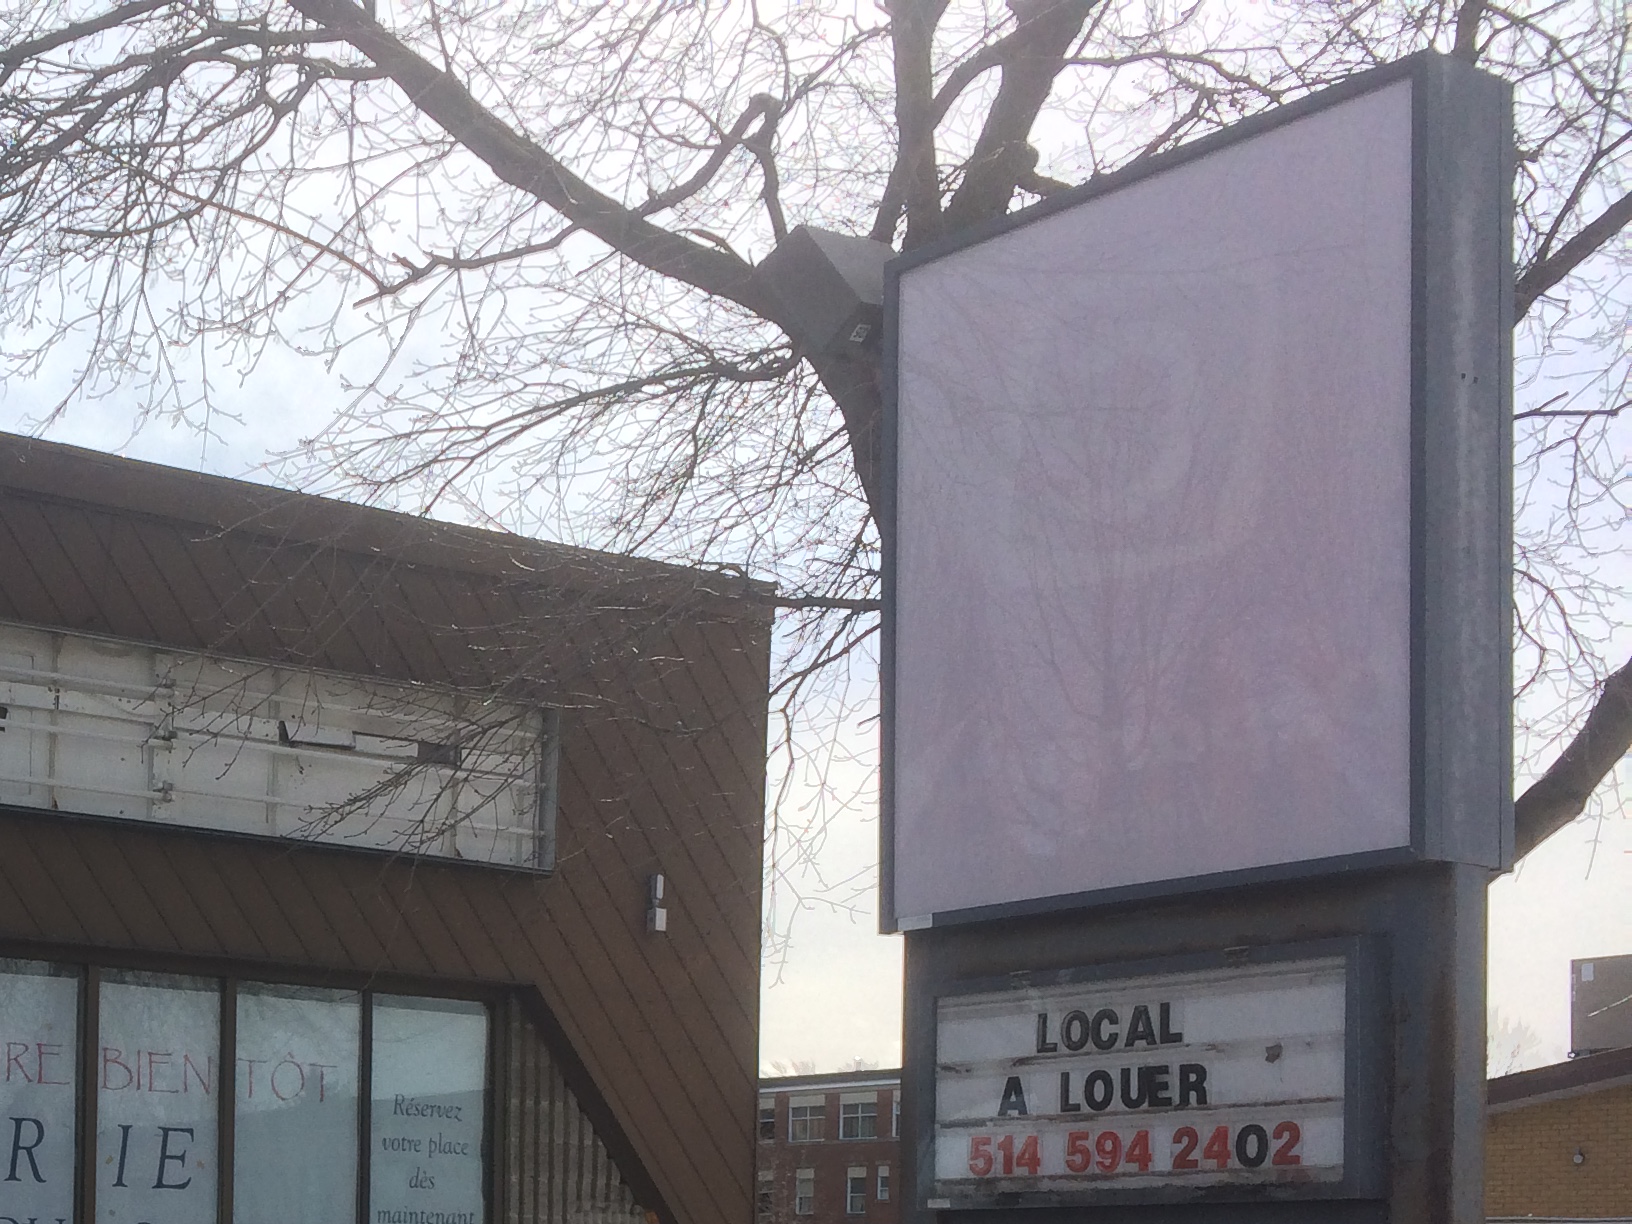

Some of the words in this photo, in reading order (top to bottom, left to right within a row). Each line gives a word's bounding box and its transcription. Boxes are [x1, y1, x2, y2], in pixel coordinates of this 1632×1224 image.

[1036, 1002, 1183, 1054] LOCAL
[392, 1092, 463, 1122] Réservez
[997, 1076, 1028, 1117] A
[1060, 1063, 1208, 1113] LOUER
[381, 1136, 422, 1153] votre
[427, 1131, 470, 1159] place
[969, 1134, 1041, 1176] 514
[1065, 1129, 1152, 1173] 594
[1172, 1121, 1302, 1170] 2402
[408, 1165, 436, 1190] dès
